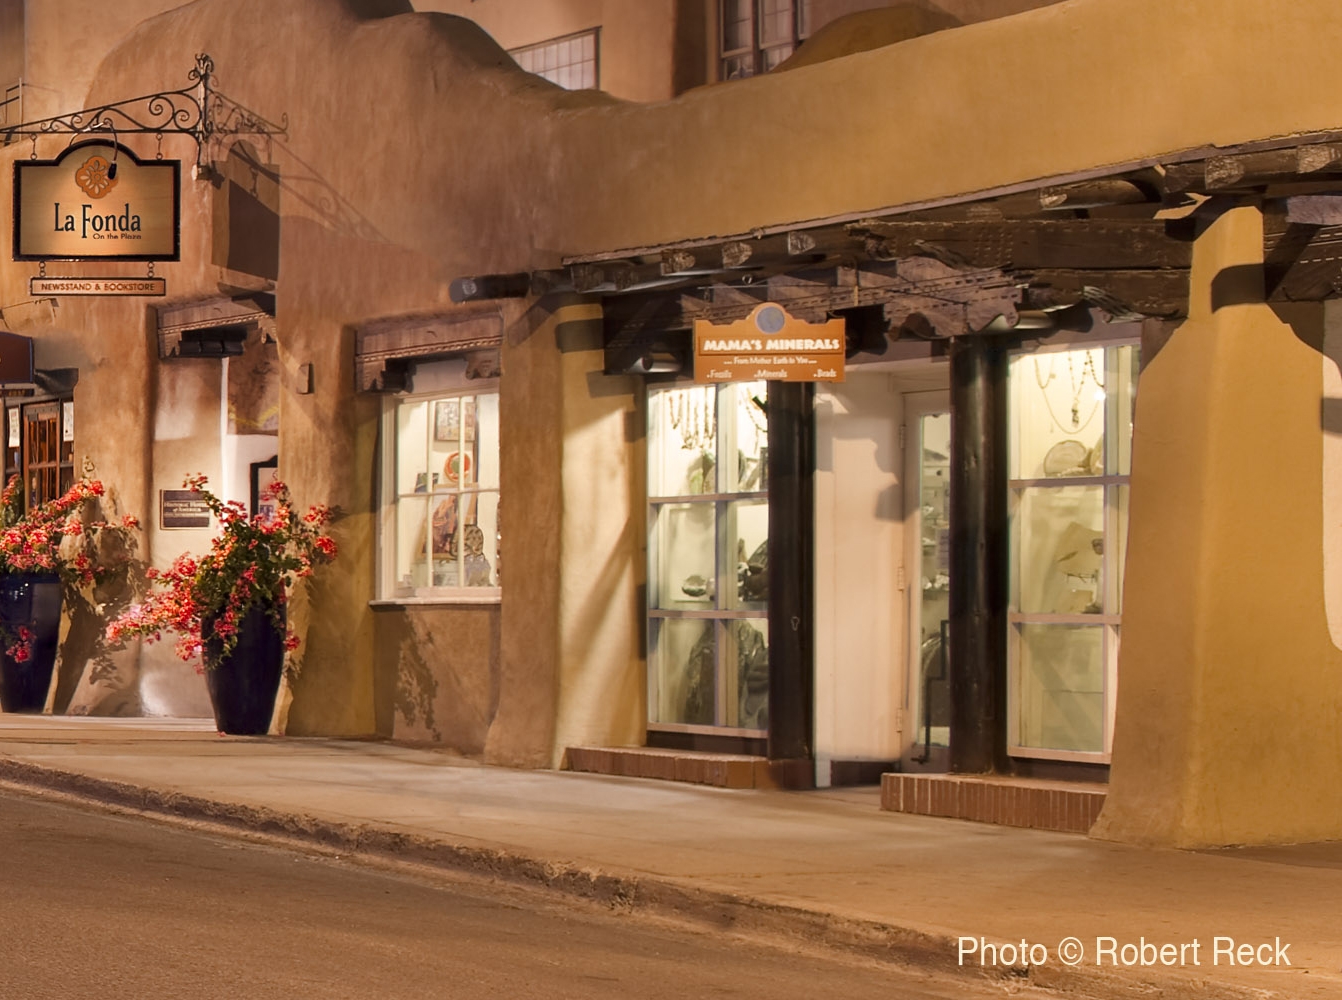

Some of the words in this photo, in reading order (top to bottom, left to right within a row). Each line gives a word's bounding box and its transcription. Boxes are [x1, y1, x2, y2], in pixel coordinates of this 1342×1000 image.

[54, 203, 75, 231] La
[81, 203, 141, 238] Fonda
[41, 283, 92, 291] NEWSSTAND
[94, 283, 101, 291] &
[104, 283, 155, 291] BOOKSTORE
[703, 340, 763, 351] MAMA'S
[765, 339, 840, 350] MINERALS
